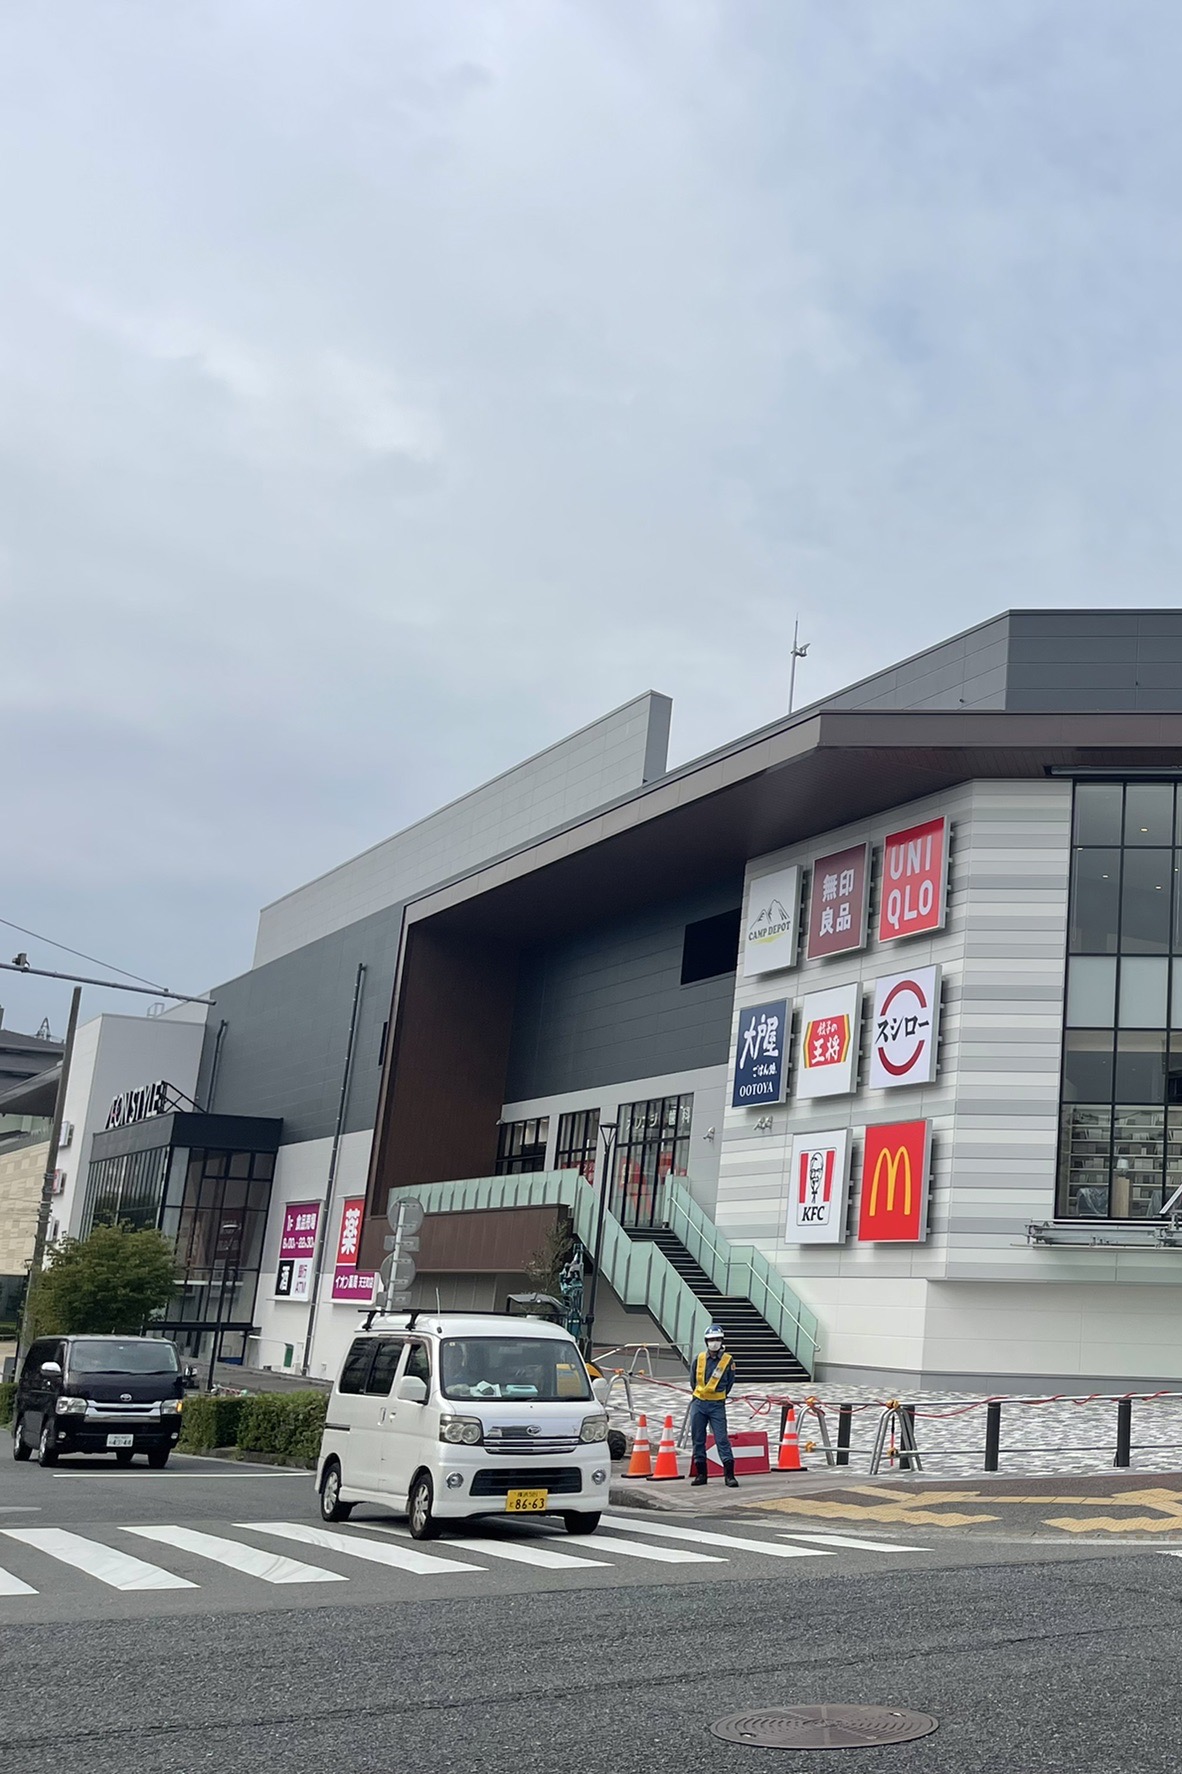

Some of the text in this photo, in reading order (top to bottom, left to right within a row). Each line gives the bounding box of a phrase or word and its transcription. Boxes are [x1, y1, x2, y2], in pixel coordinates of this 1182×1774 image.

[890, 835, 932, 880] UNI
[823, 869, 855, 902] 無印
[820, 902, 852, 937] 良品
[888, 880, 933, 930] QLO
[748, 920, 791, 941] CAMP DEPOT
[740, 1013, 779, 1070] 大戸屋
[875, 1015, 930, 1044] スシロー
[811, 1034, 840, 1064] 王将
[129, 1080, 162, 1124] STYLE
[740, 1081, 773, 1098] OOTOYA
[801, 1206, 825, 1222] KFC
[341, 1208, 361, 1255] 薬
[515, 1498, 544, 1509] 86-63
